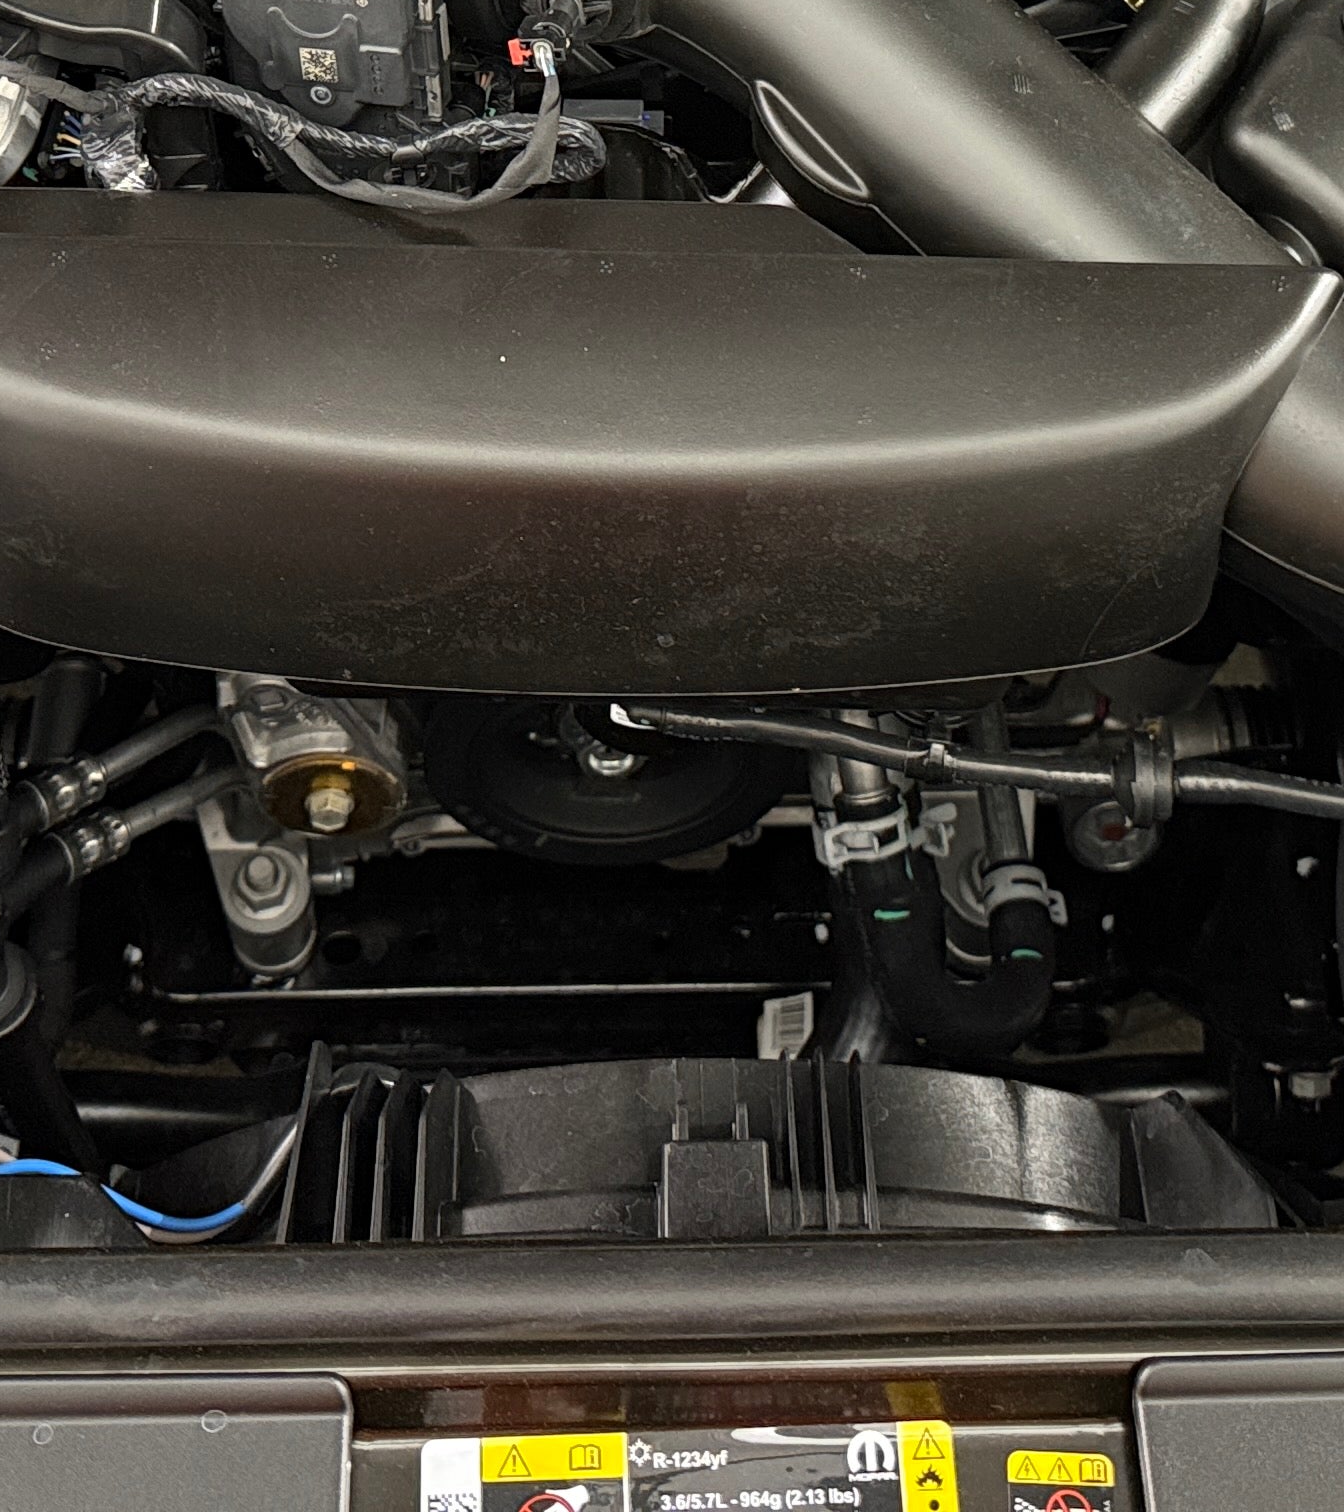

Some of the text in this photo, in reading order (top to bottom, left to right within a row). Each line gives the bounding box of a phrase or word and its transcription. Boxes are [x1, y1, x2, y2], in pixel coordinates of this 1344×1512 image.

[652, 1450, 729, 1471] R-1234yf
[660, 1493, 728, 1511] 3.6/5.7L
[739, 1491, 782, 1511] 964g
[785, 1489, 826, 1510] (2.13
[828, 1486, 861, 1507] lbs)
